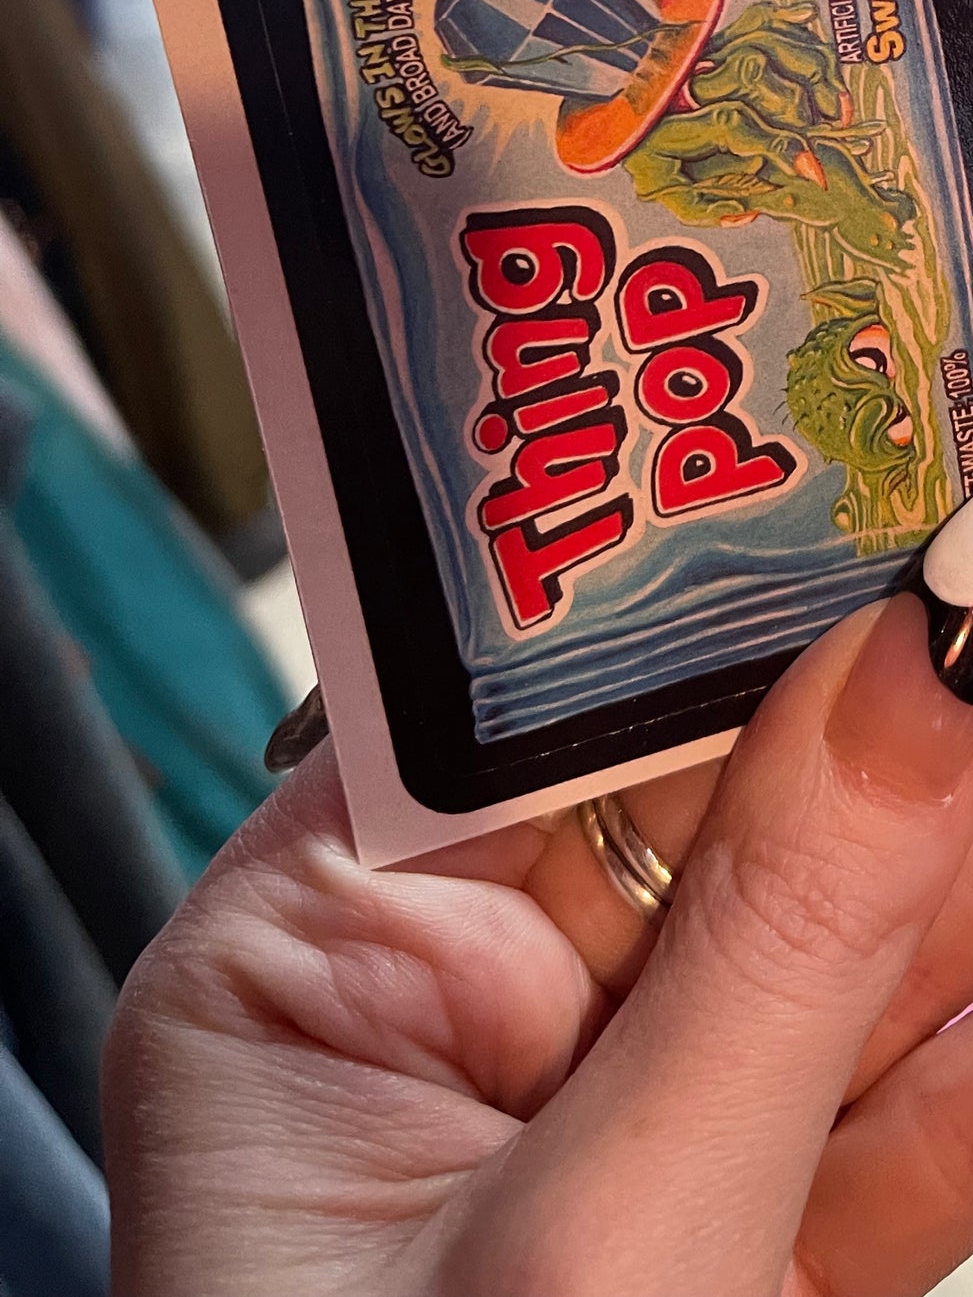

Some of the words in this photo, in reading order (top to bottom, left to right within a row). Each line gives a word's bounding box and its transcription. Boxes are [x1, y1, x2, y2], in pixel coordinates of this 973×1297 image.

[357, 43, 396, 84] IN
[391, 36, 437, 104] BROAD
[375, 84, 454, 177] GLOWS
[422, 102, 473, 150] (AND
[943, 351, 972, 399] 100%
[462, 205, 634, 630] Thing
